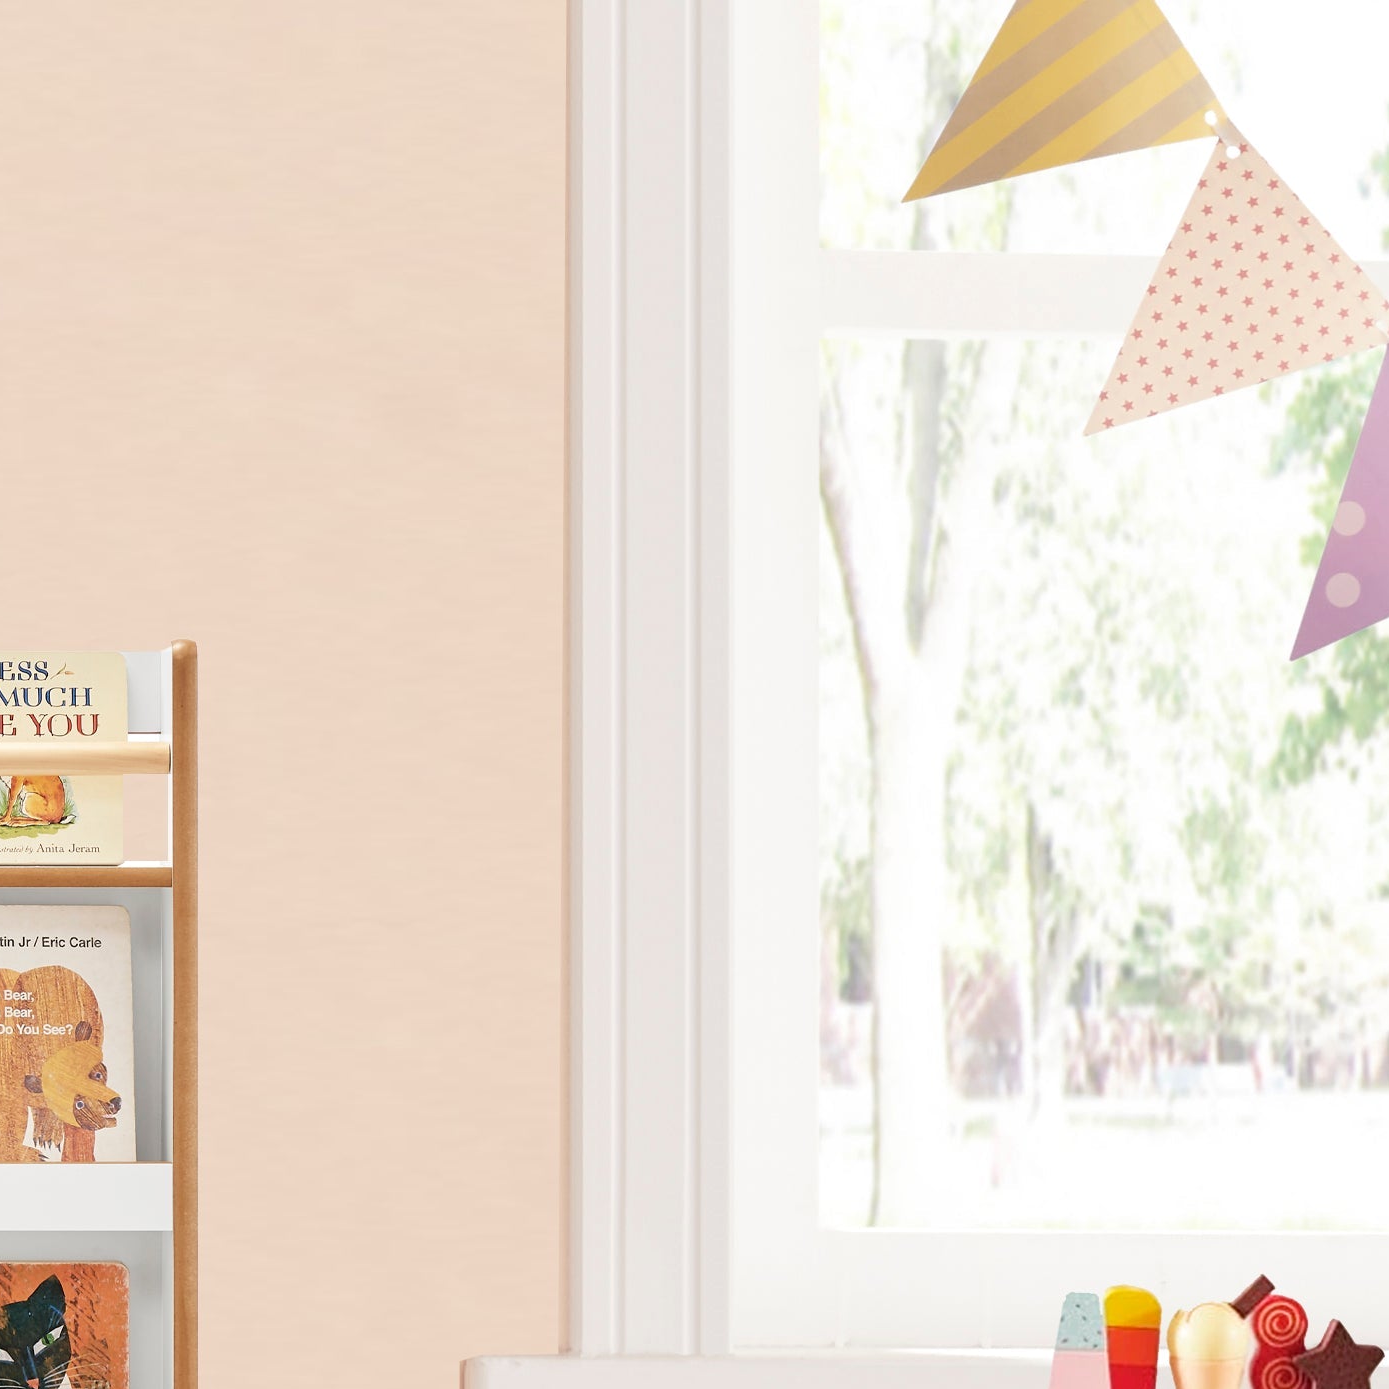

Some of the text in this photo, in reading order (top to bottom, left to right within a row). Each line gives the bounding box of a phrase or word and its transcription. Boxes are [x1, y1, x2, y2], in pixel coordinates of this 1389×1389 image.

[27, 713, 100, 737] YOU
[36, 843, 65, 853] Anita
[68, 843, 101, 853] Jeram
[18, 936, 31, 948] Jr
[42, 937, 66, 948] Eric
[69, 937, 102, 948] Carle
[4, 990, 34, 1002] Bear,
[5, 1006, 35, 1019] Bear,
[16, 1024, 39, 1035] You
[43, 1024, 73, 1035] See?
